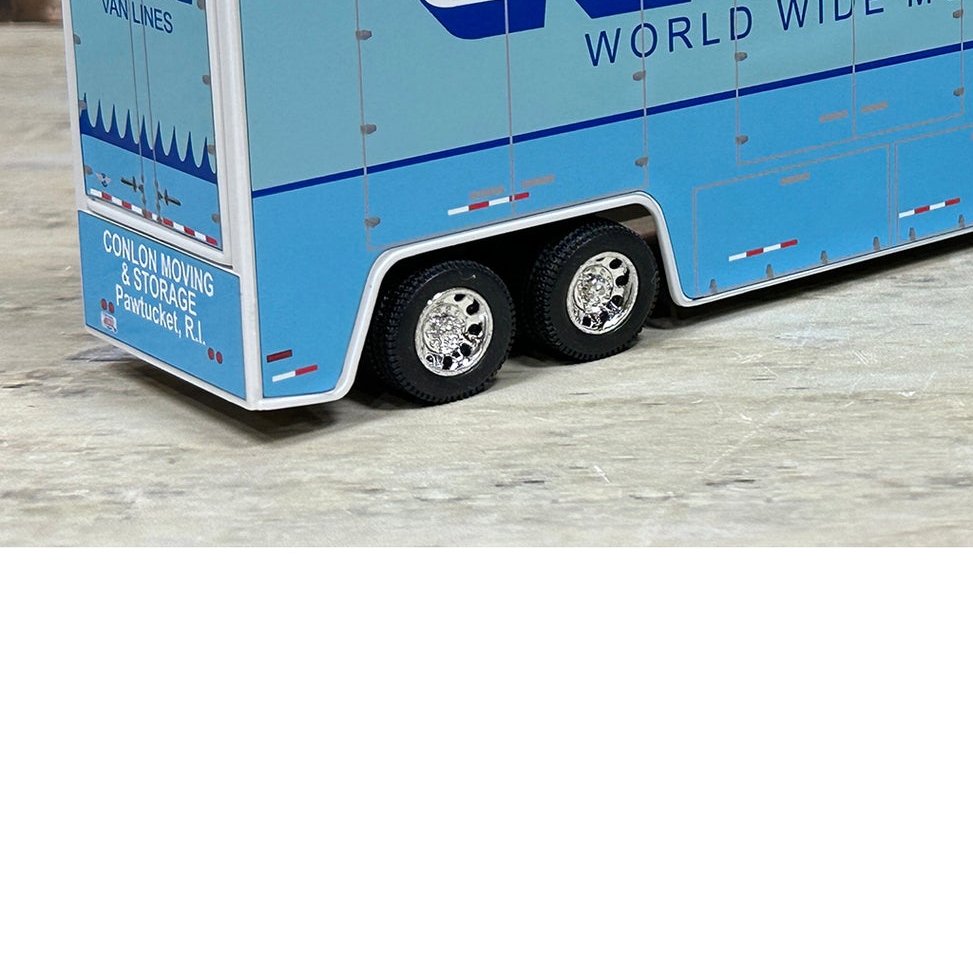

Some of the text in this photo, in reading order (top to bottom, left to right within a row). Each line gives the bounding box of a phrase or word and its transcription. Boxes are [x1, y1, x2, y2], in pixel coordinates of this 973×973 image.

[132, 1, 173, 34] LINES
[585, 5, 752, 67] WORLD
[103, 229, 214, 297] CONLON MOVING
[121, 262, 197, 316] & STORAGE
[115, 283, 207, 346] Pawtucket, R.I.
